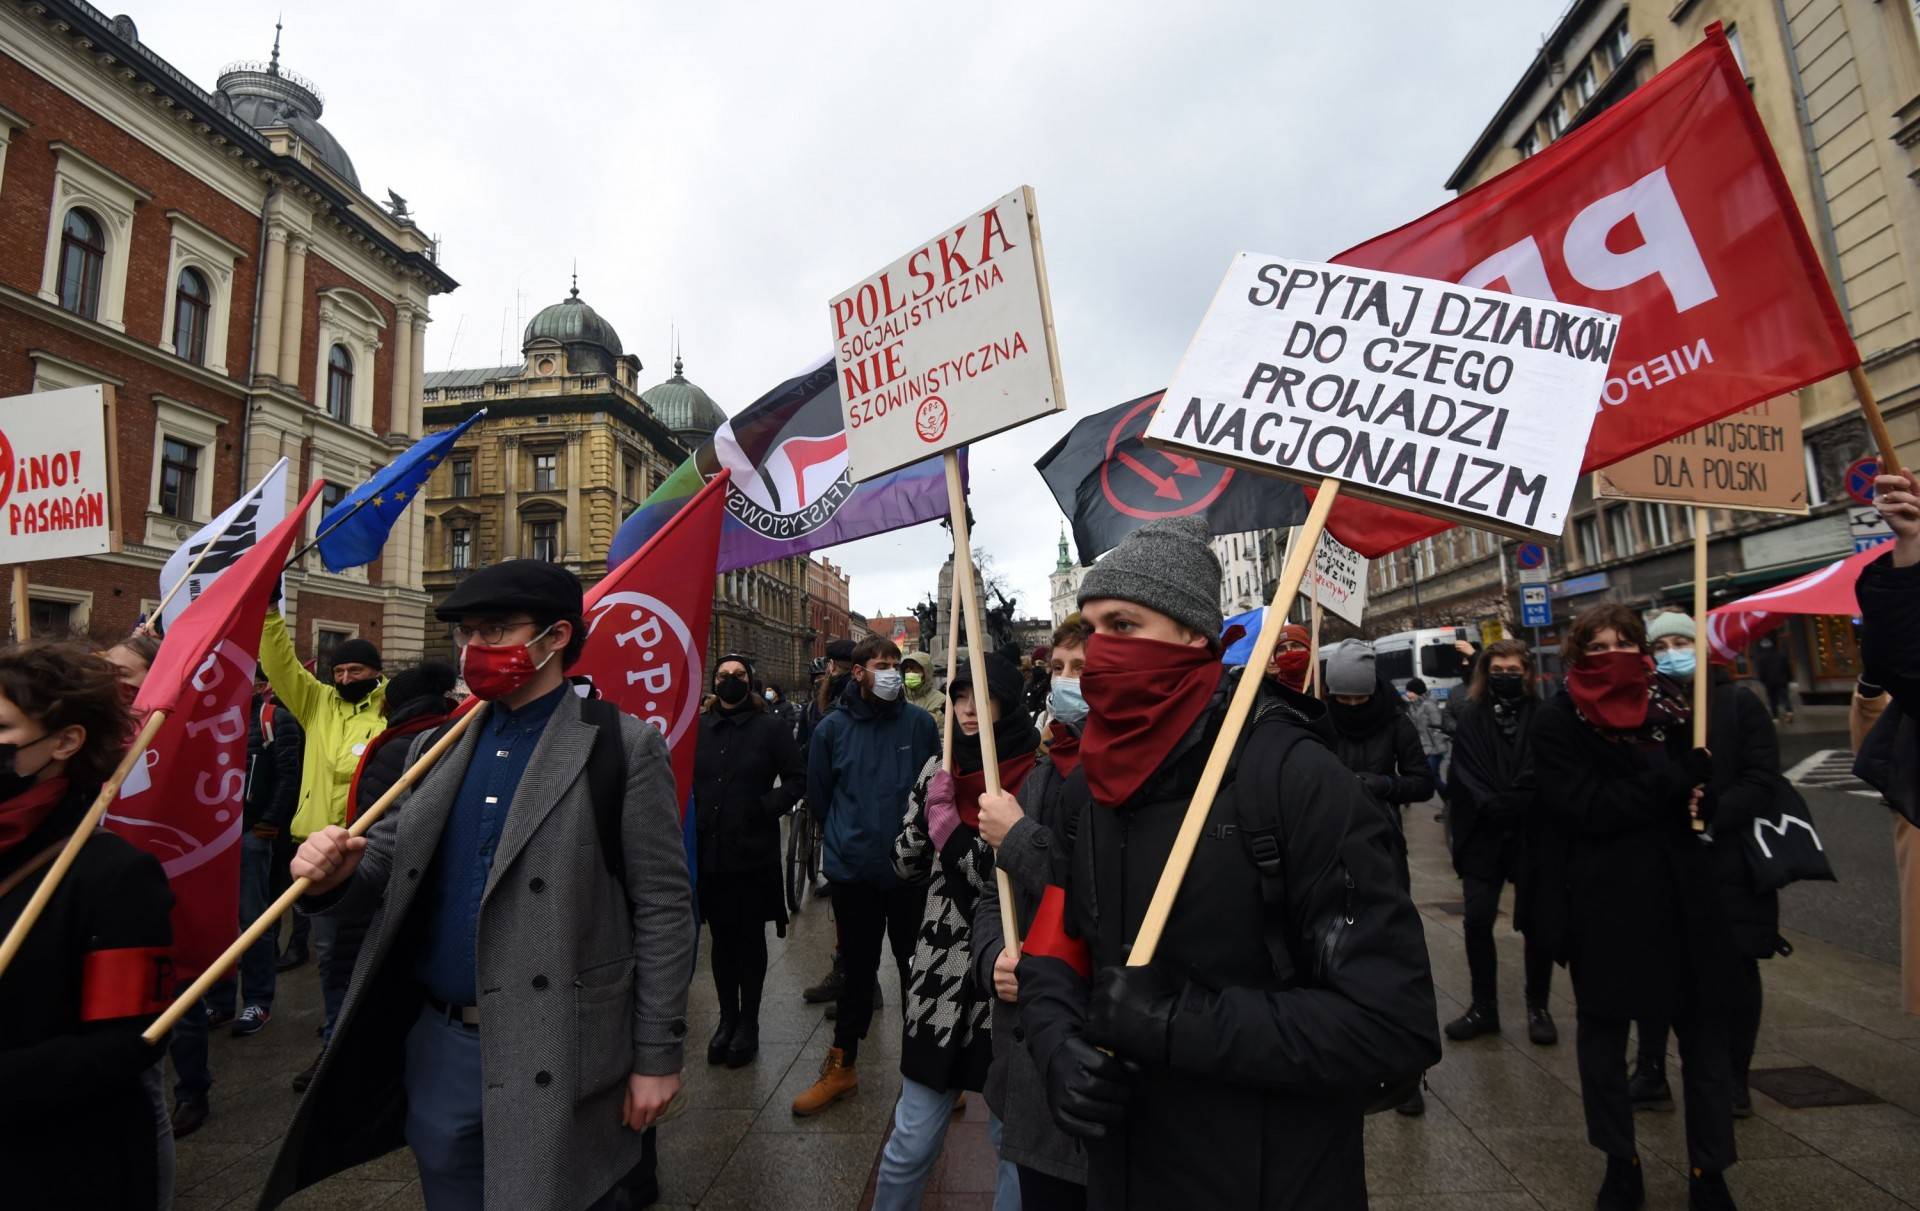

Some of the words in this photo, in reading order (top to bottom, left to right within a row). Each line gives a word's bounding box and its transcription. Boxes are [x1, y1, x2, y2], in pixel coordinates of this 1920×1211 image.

[832, 206, 1017, 341] POLSKA
[841, 263, 1004, 363] SOCJALISTYCZNA
[1248, 263, 1423, 338] SPYTAJ
[1430, 292, 1617, 365] DZIADKÓW
[842, 339, 908, 402] NIE
[849, 330, 1029, 429] SZOWINISTYCZNA
[1284, 321, 1347, 364] DO
[1362, 336, 1514, 395] CZEGO
[1242, 362, 1509, 450] PROWADZI
[1173, 397, 1548, 527] NACJONALIZM
[1654, 454, 1694, 488] DLA
[1703, 458, 1768, 492] POLSKI
[9, 488, 104, 536] PASARÁN
